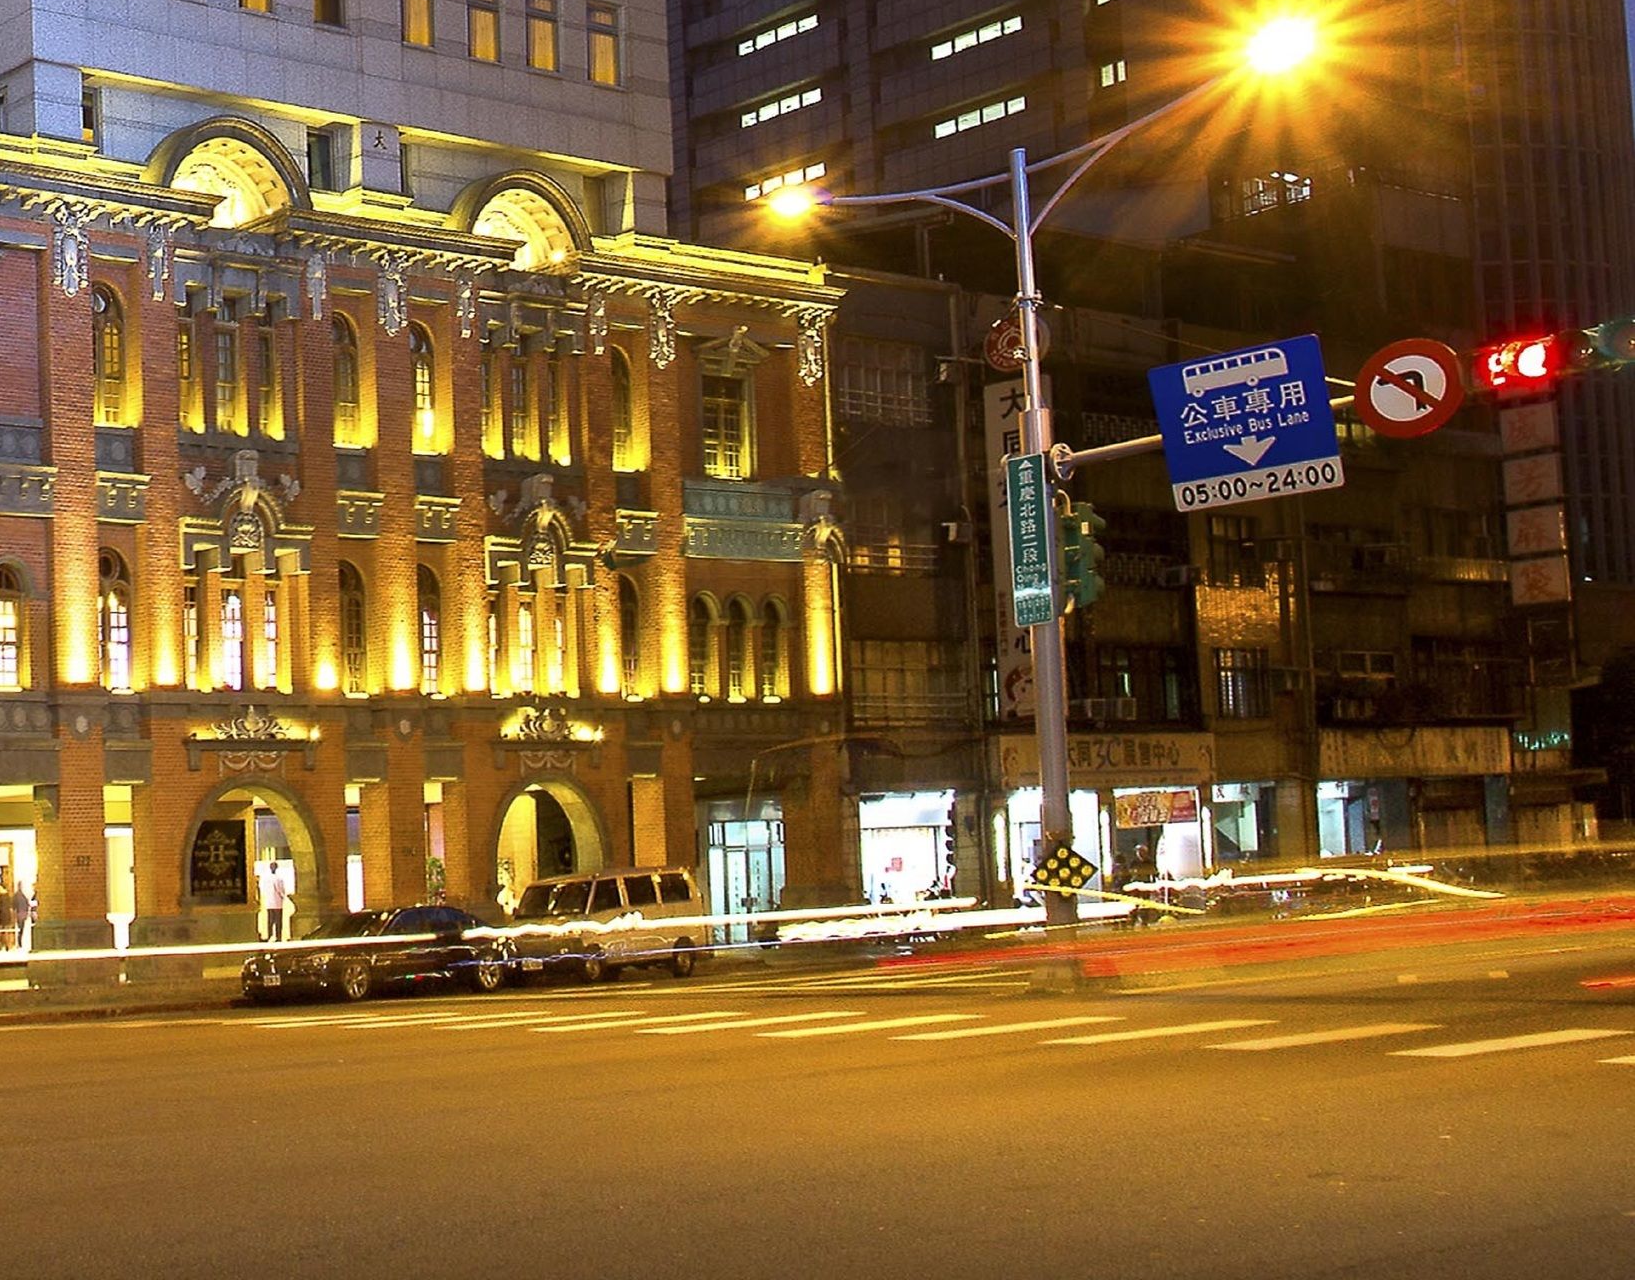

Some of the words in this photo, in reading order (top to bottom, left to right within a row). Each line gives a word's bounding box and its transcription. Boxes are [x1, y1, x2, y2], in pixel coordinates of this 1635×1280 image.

[1180, 380, 1306, 427] 公車專用
[1184, 423, 1243, 444] Exclusive
[1248, 417, 1272, 433] Bus
[1277, 410, 1309, 427] Lane
[1182, 462, 1335, 506] 05:00~24:00
[1018, 469, 1038, 563] 重慶北路二段
